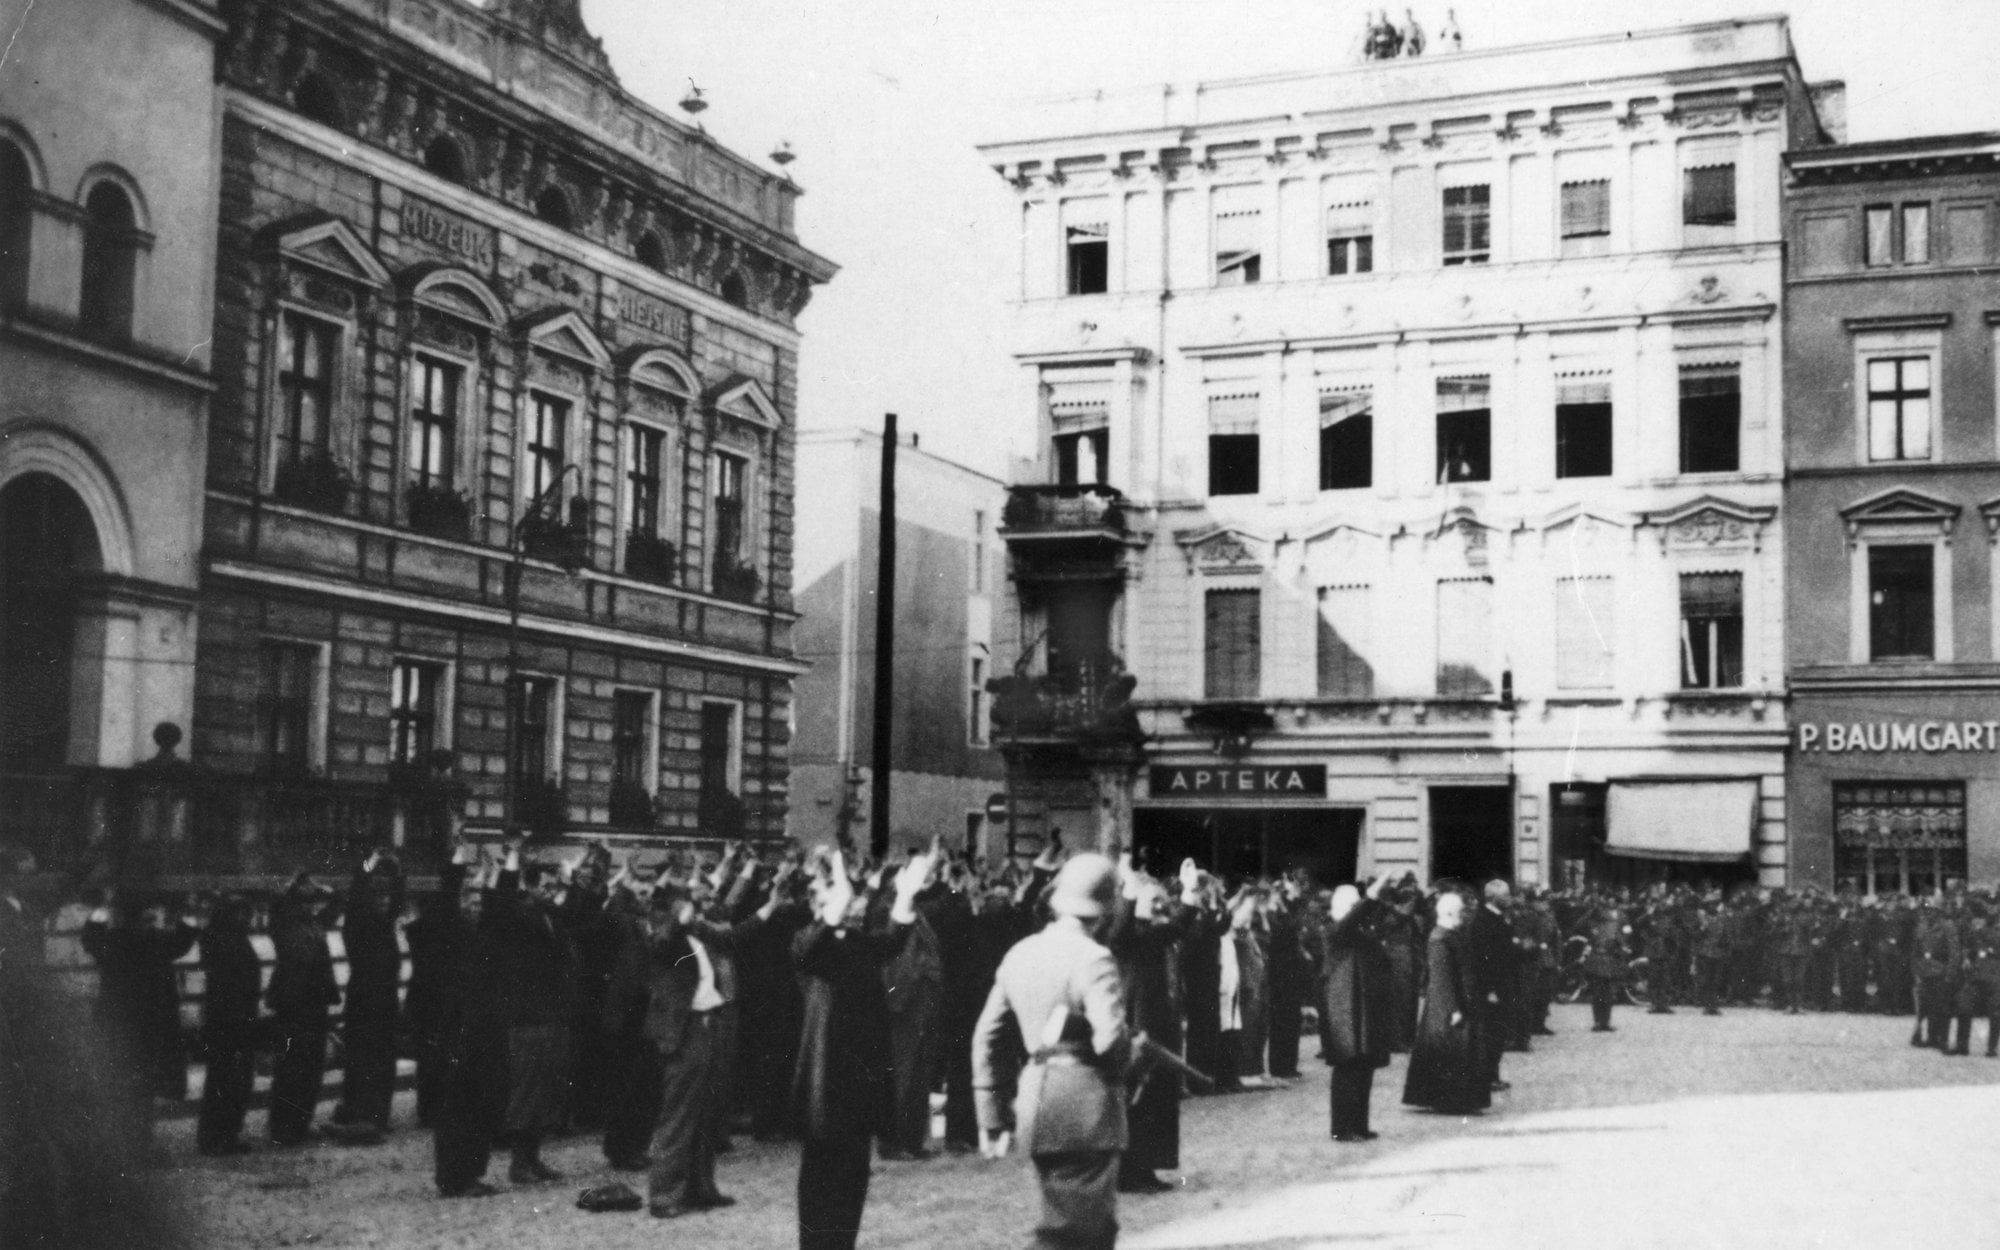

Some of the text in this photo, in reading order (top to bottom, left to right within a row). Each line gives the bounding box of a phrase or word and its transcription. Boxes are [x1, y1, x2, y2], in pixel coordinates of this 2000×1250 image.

[1800, 722, 2000, 751] P. BAUMGART
[1171, 771, 1304, 790] APTEKA
